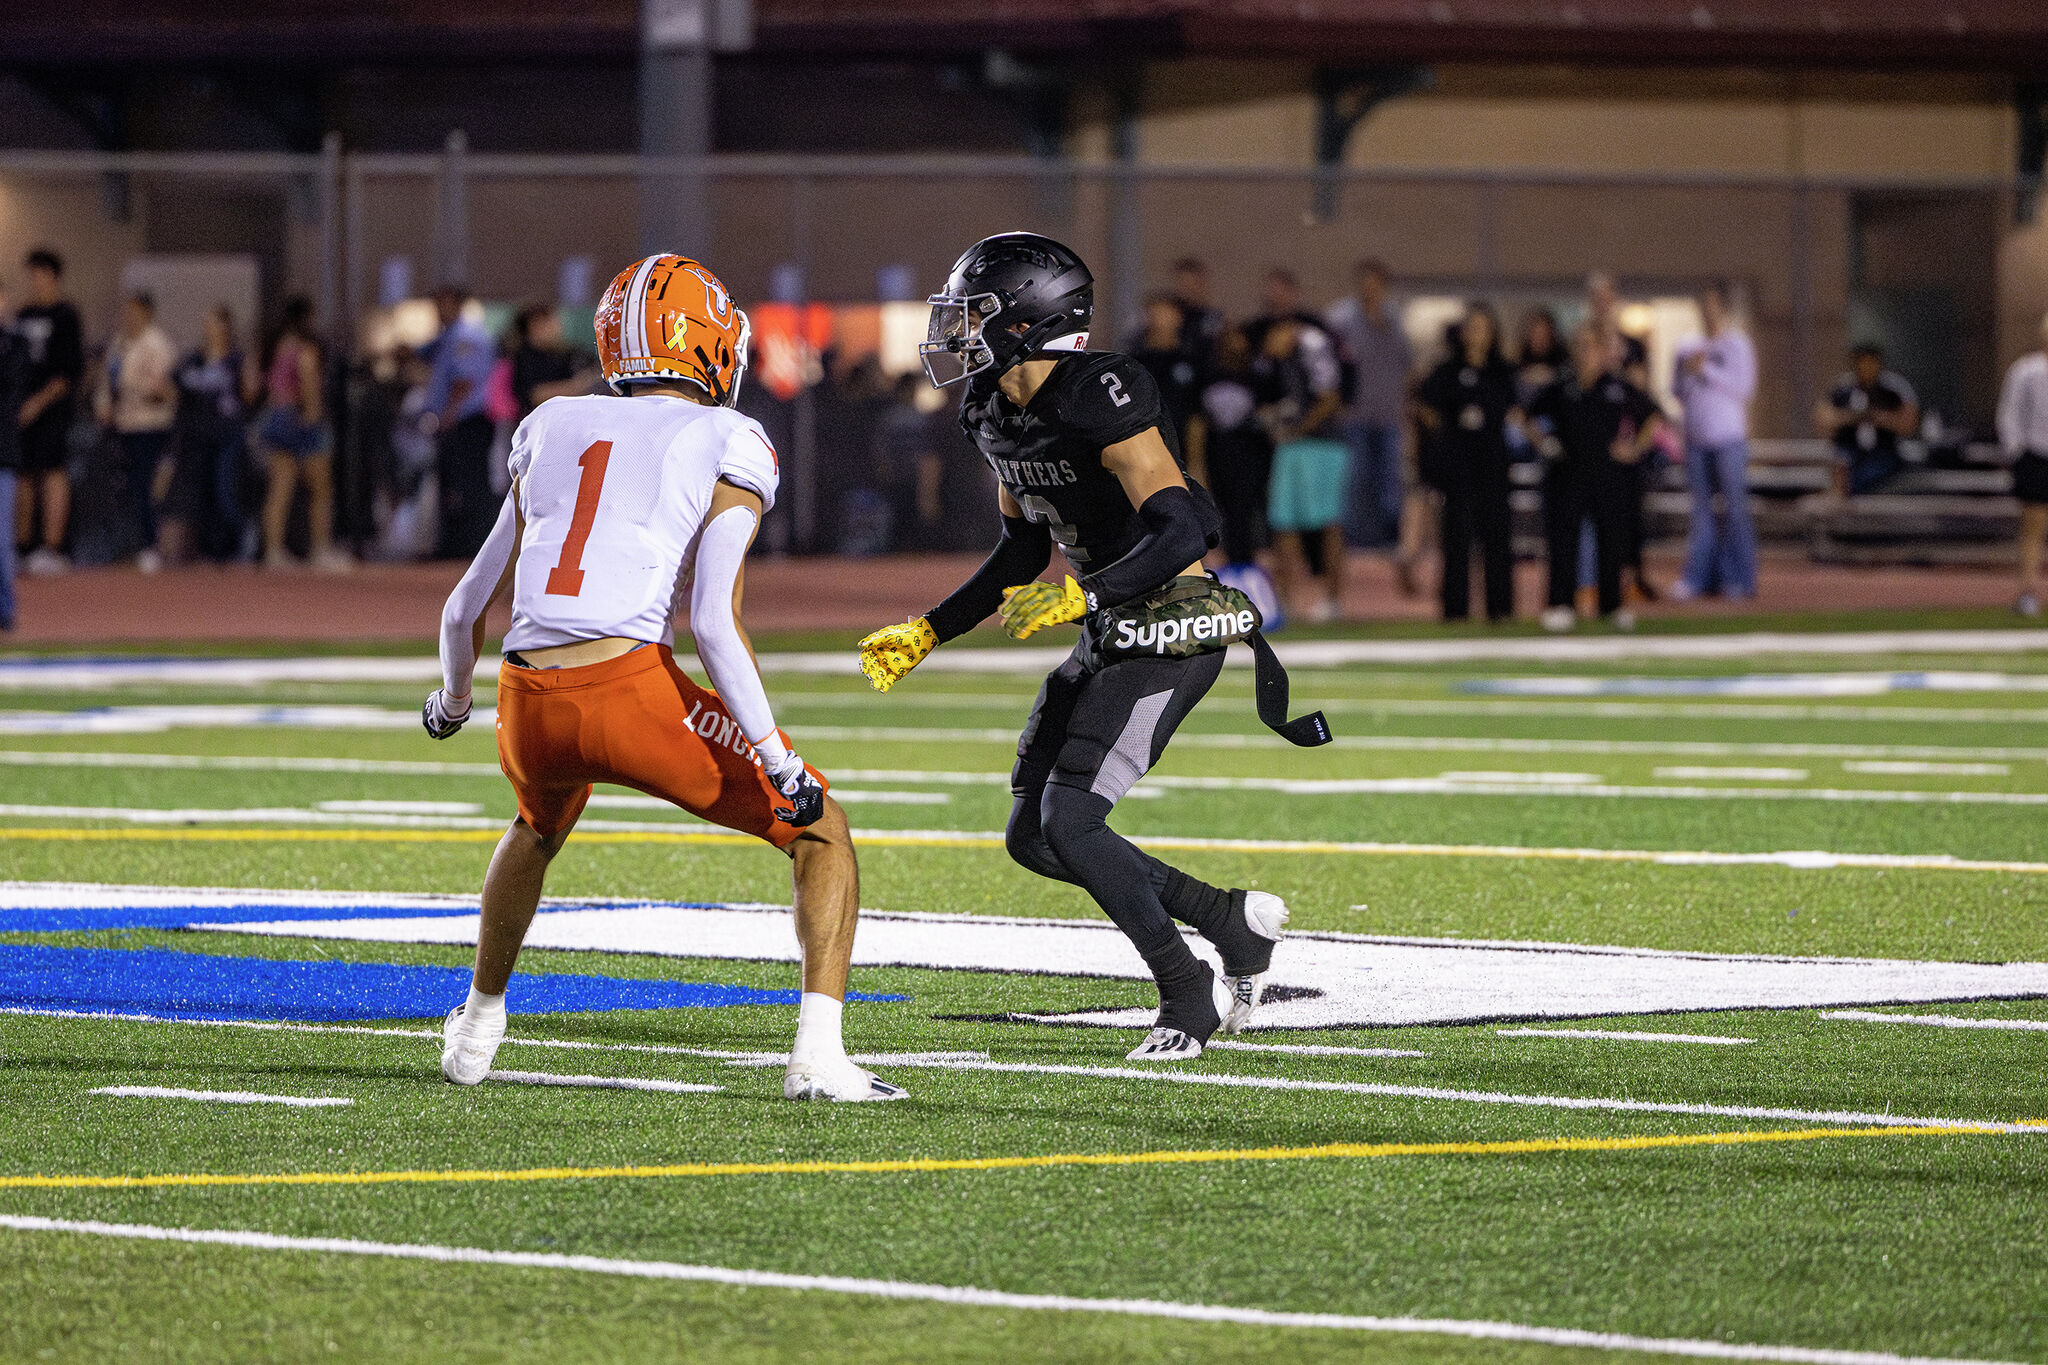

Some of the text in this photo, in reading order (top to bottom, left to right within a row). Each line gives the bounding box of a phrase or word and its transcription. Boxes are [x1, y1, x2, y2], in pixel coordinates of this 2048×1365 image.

[619, 358, 655, 372] FAMILY
[1100, 372, 1131, 407] 2
[545, 440, 613, 597] 1
[1024, 494, 1092, 562] 2
[1114, 609, 1255, 655] Supreme
